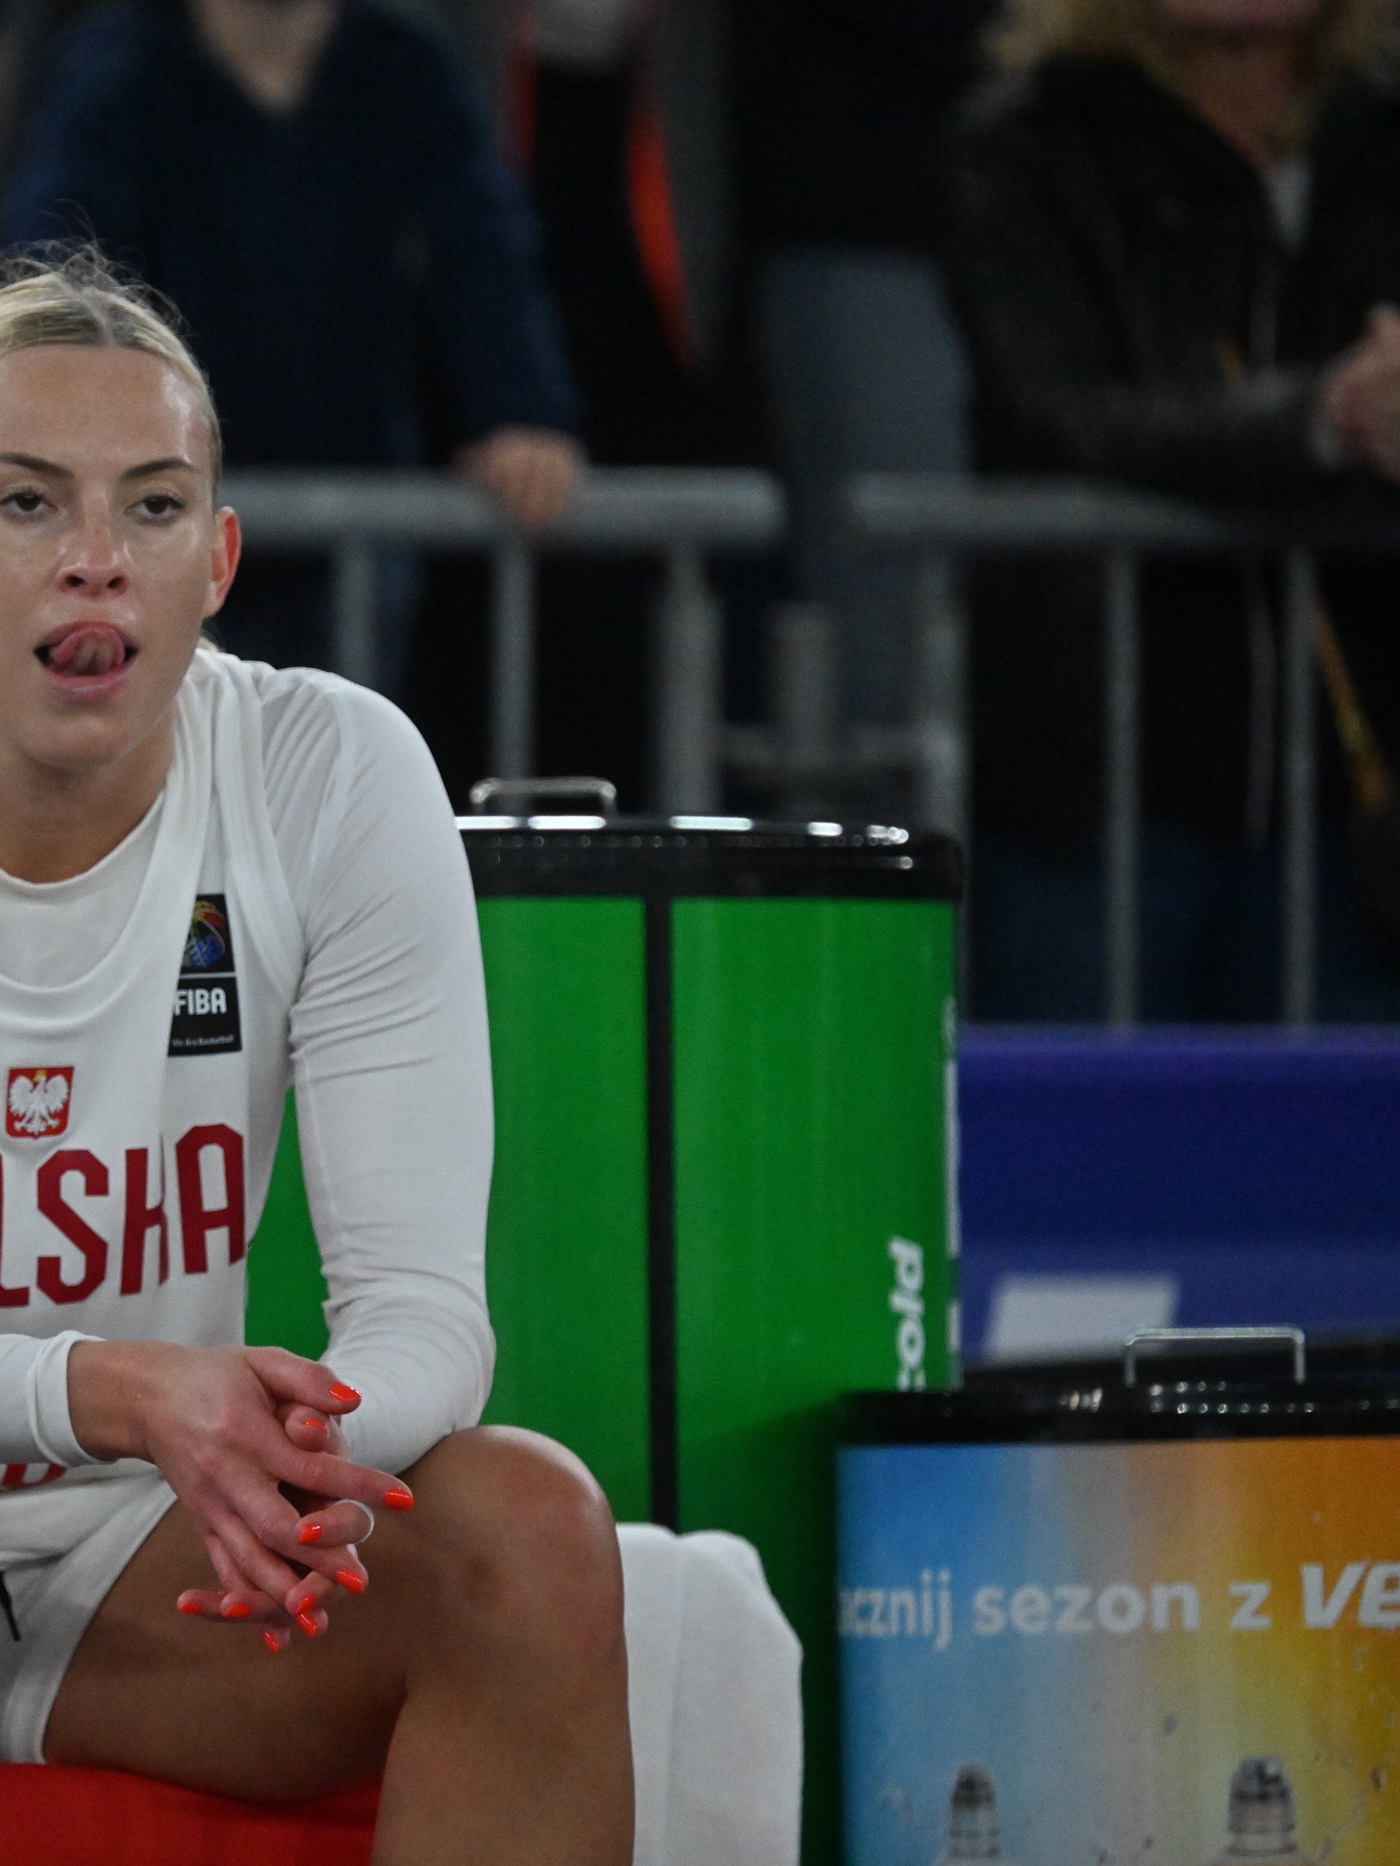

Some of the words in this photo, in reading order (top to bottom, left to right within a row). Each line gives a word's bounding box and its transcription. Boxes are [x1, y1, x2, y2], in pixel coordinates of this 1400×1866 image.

[173, 986, 228, 1016] FIBA
[973, 1581, 1200, 1633] sezon
[1230, 1580, 1272, 1631] z
